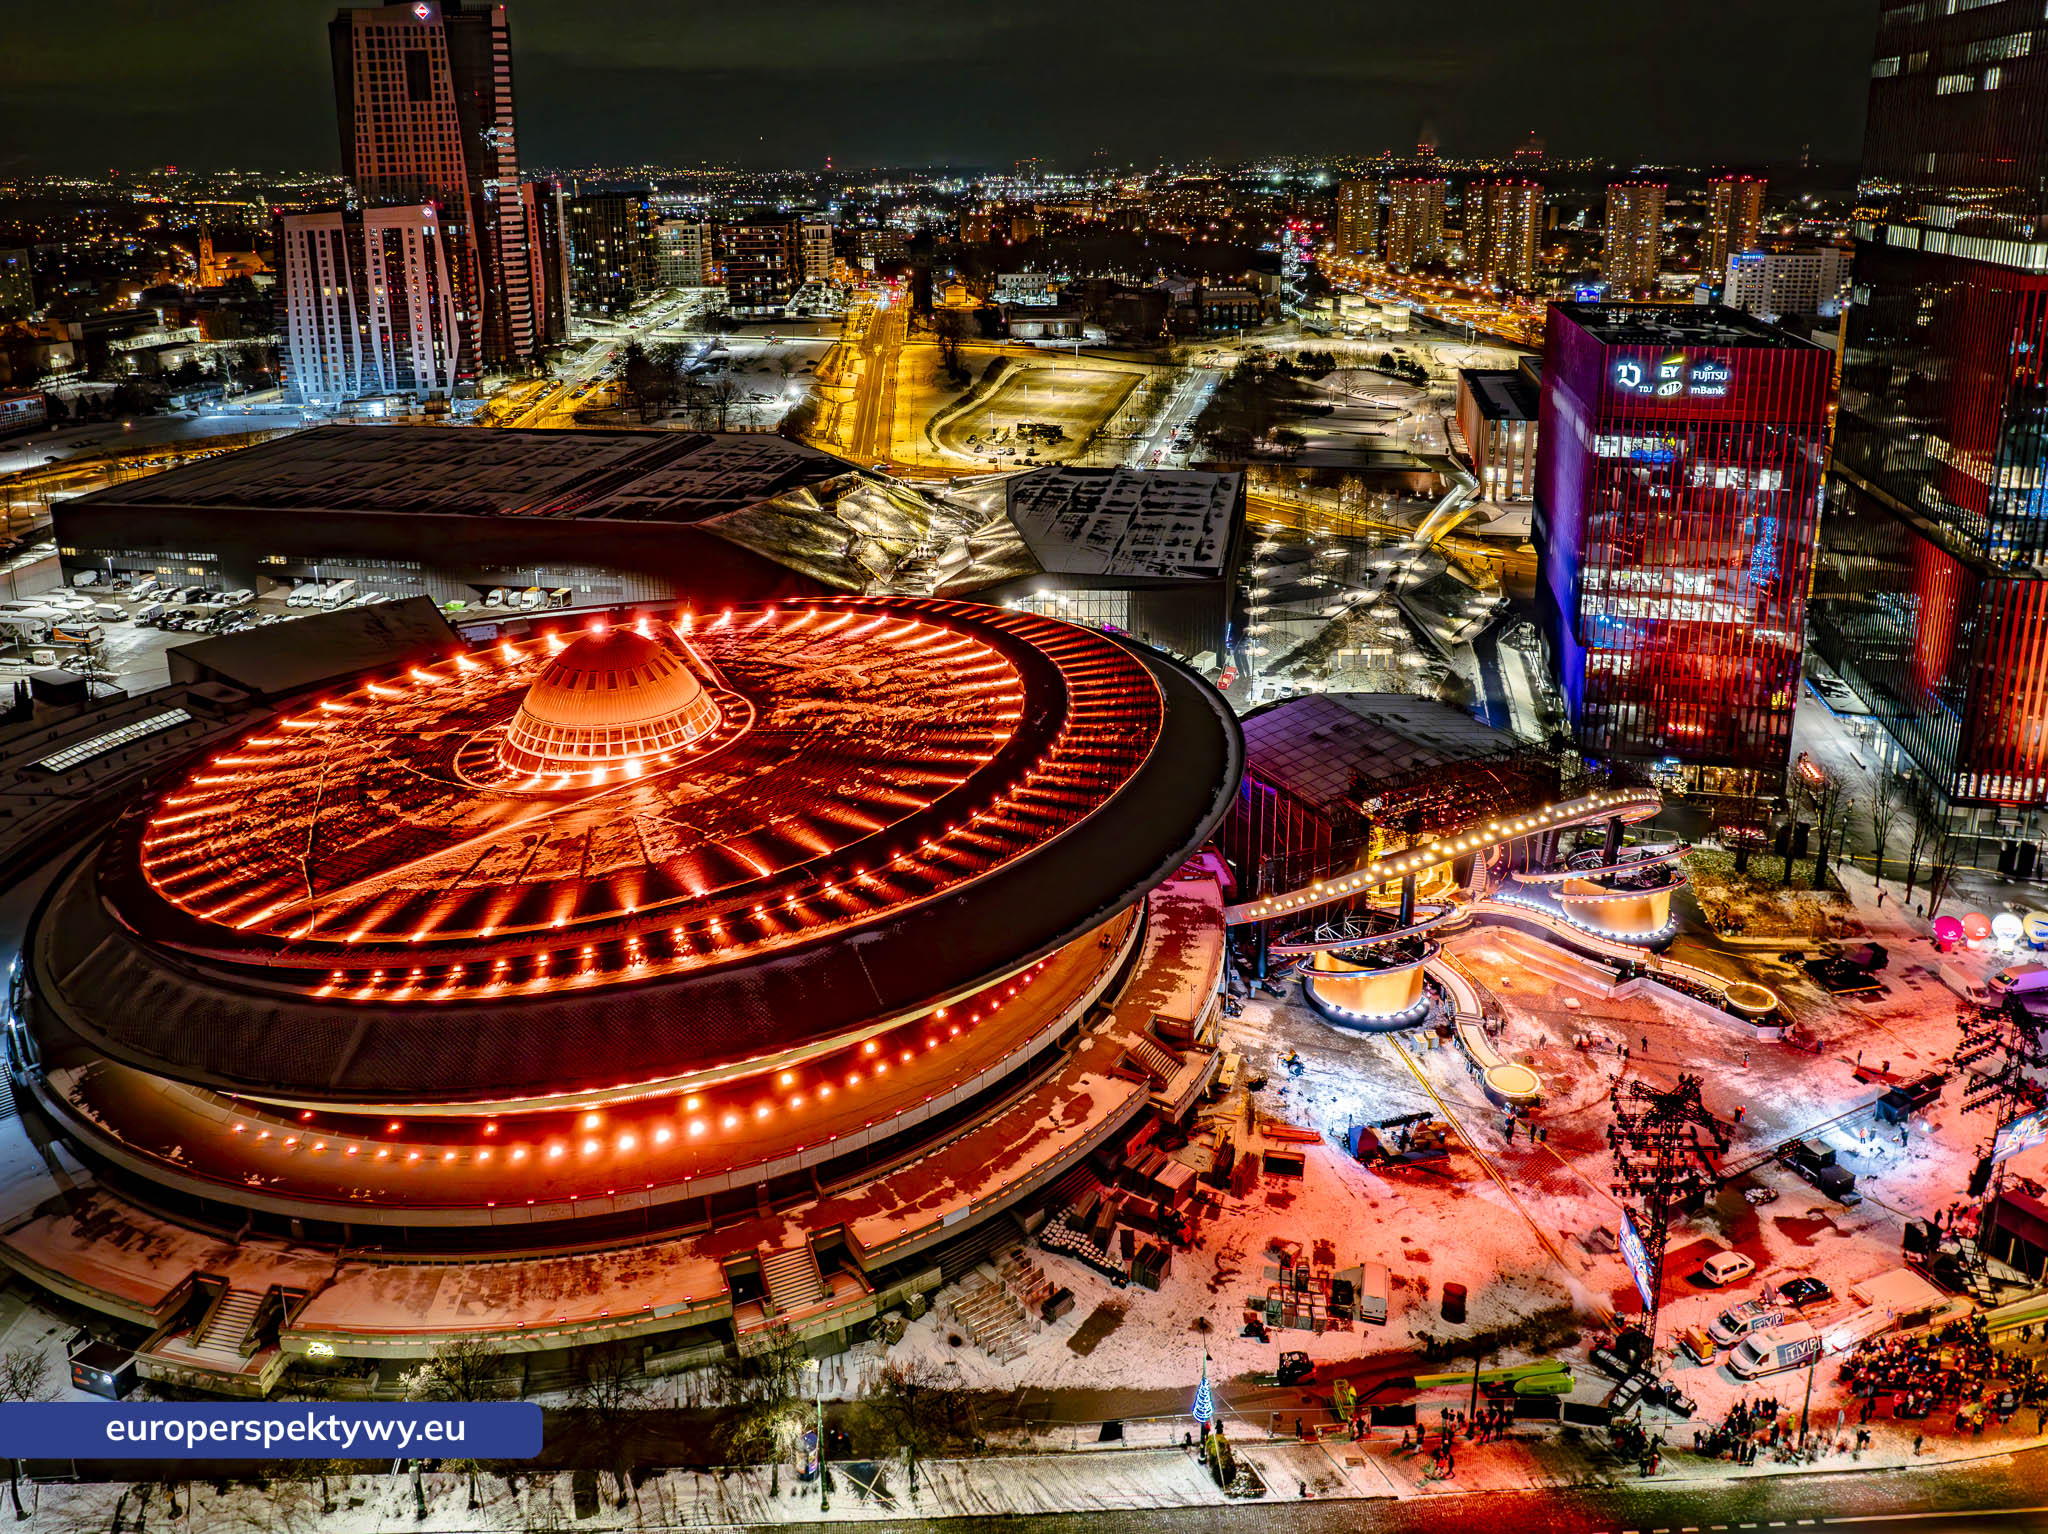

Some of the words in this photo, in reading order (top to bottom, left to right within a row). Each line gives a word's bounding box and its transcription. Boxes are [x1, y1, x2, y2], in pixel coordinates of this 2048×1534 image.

[1660, 366, 1680, 378] EY
[1692, 369, 1728, 382] FUJITSU
[1639, 386, 1653, 394] TDJ
[1691, 386, 1725, 395] mBank
[1787, 1338, 1818, 1361] TVP
